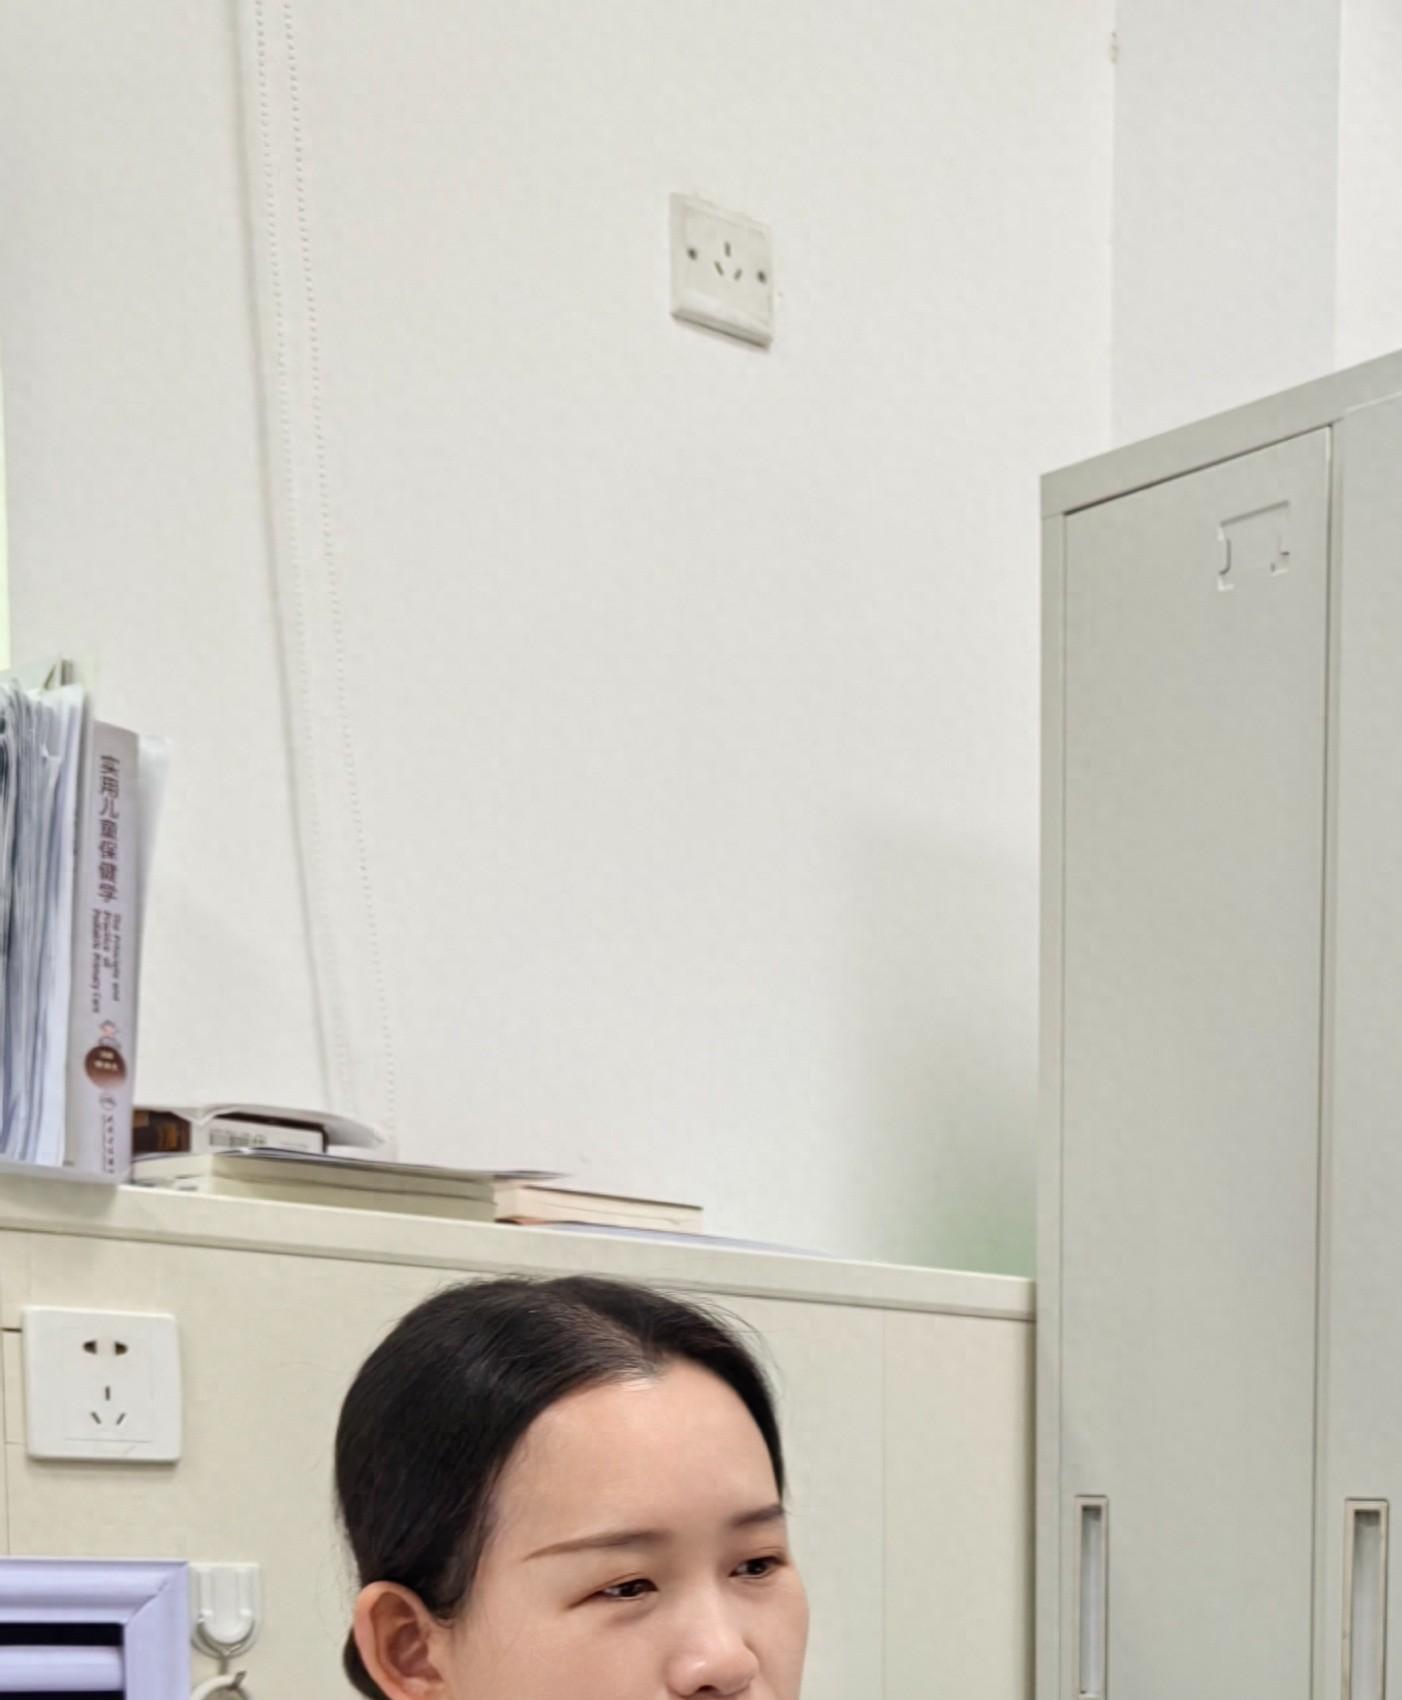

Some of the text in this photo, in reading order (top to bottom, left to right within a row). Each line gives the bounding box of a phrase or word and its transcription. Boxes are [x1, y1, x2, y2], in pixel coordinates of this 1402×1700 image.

[98, 755, 120, 903] 实用儿童保健学
